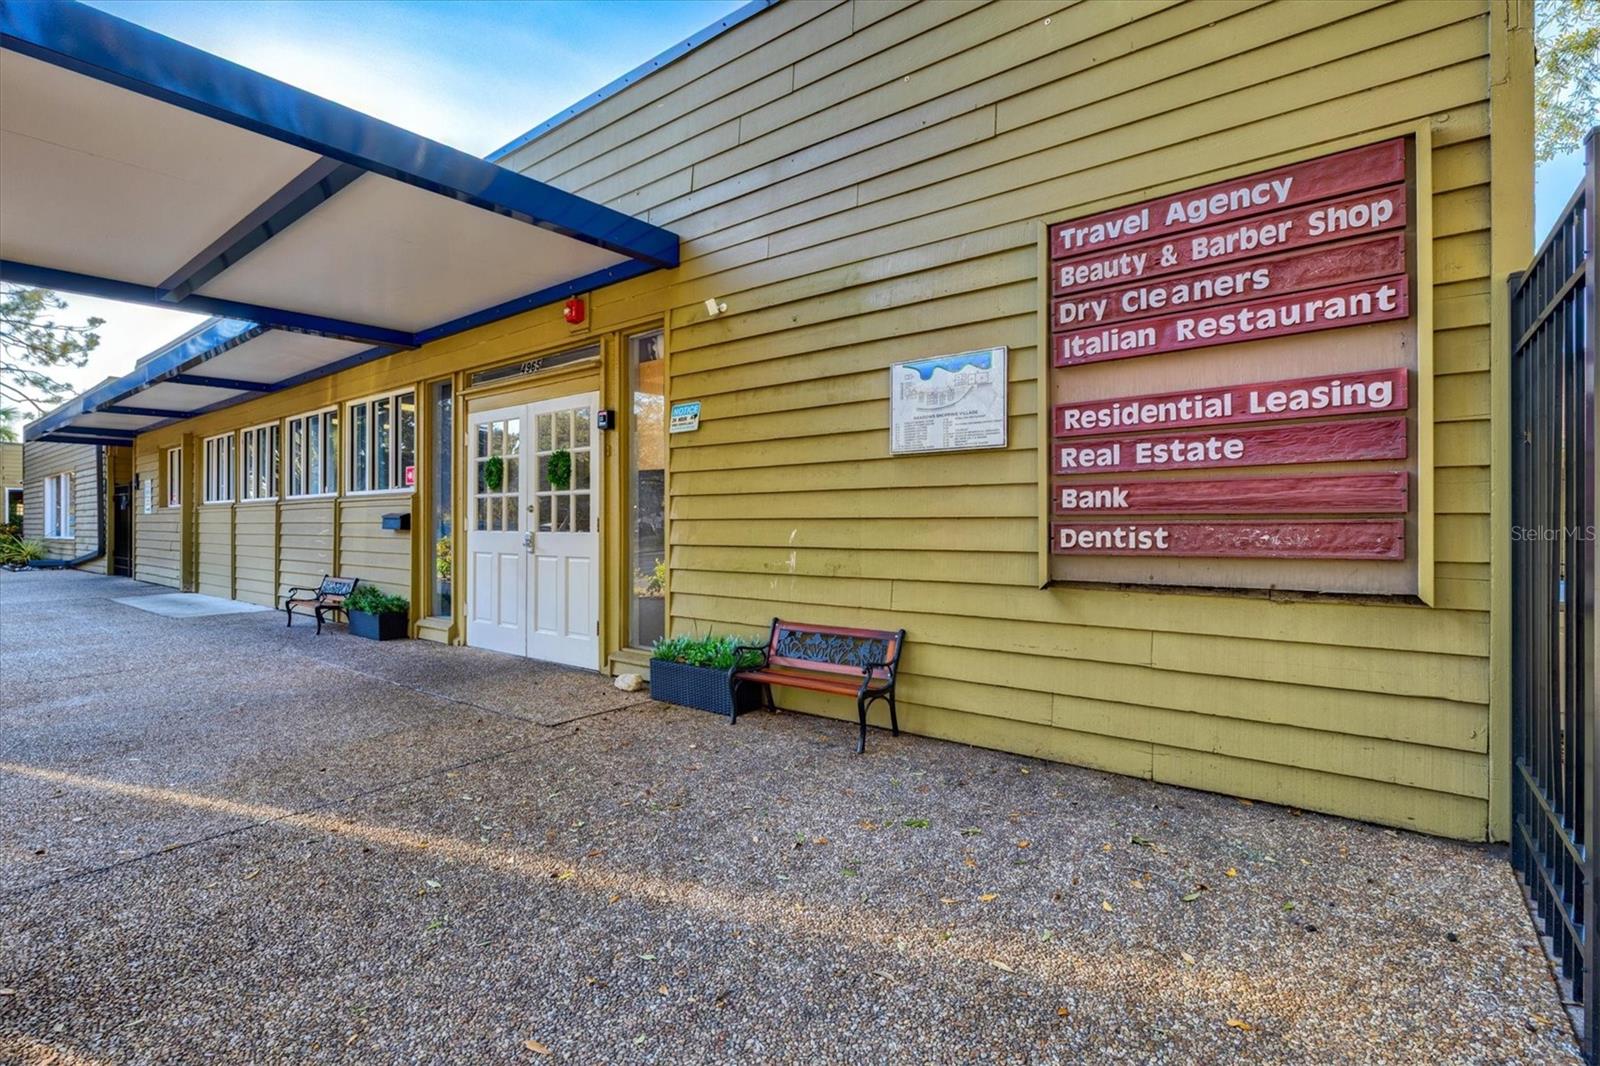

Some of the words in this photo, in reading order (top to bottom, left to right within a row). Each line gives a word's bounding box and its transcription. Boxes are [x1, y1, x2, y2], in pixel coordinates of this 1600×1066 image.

[1060, 208, 1149, 250] Travel
[1165, 177, 1293, 226] Agency
[1061, 252, 1148, 287] Beauty
[1160, 244, 1178, 267] &
[1192, 220, 1292, 261] Barber
[1308, 199, 1393, 236] Shop
[1060, 299, 1107, 324] Dry
[1122, 268, 1270, 313] Cleaners
[1064, 328, 1156, 359] Italian
[1177, 285, 1396, 342] Restaurant
[520, 359, 544, 374] 4965
[673, 404, 699, 416] NOTICE
[1064, 393, 1232, 430] Residential
[1250, 380, 1393, 414] Leasing
[1061, 444, 1121, 468] Real
[1136, 437, 1244, 464] Estate
[1062, 486, 1129, 509] Bank
[1060, 526, 1169, 549] Dentist
